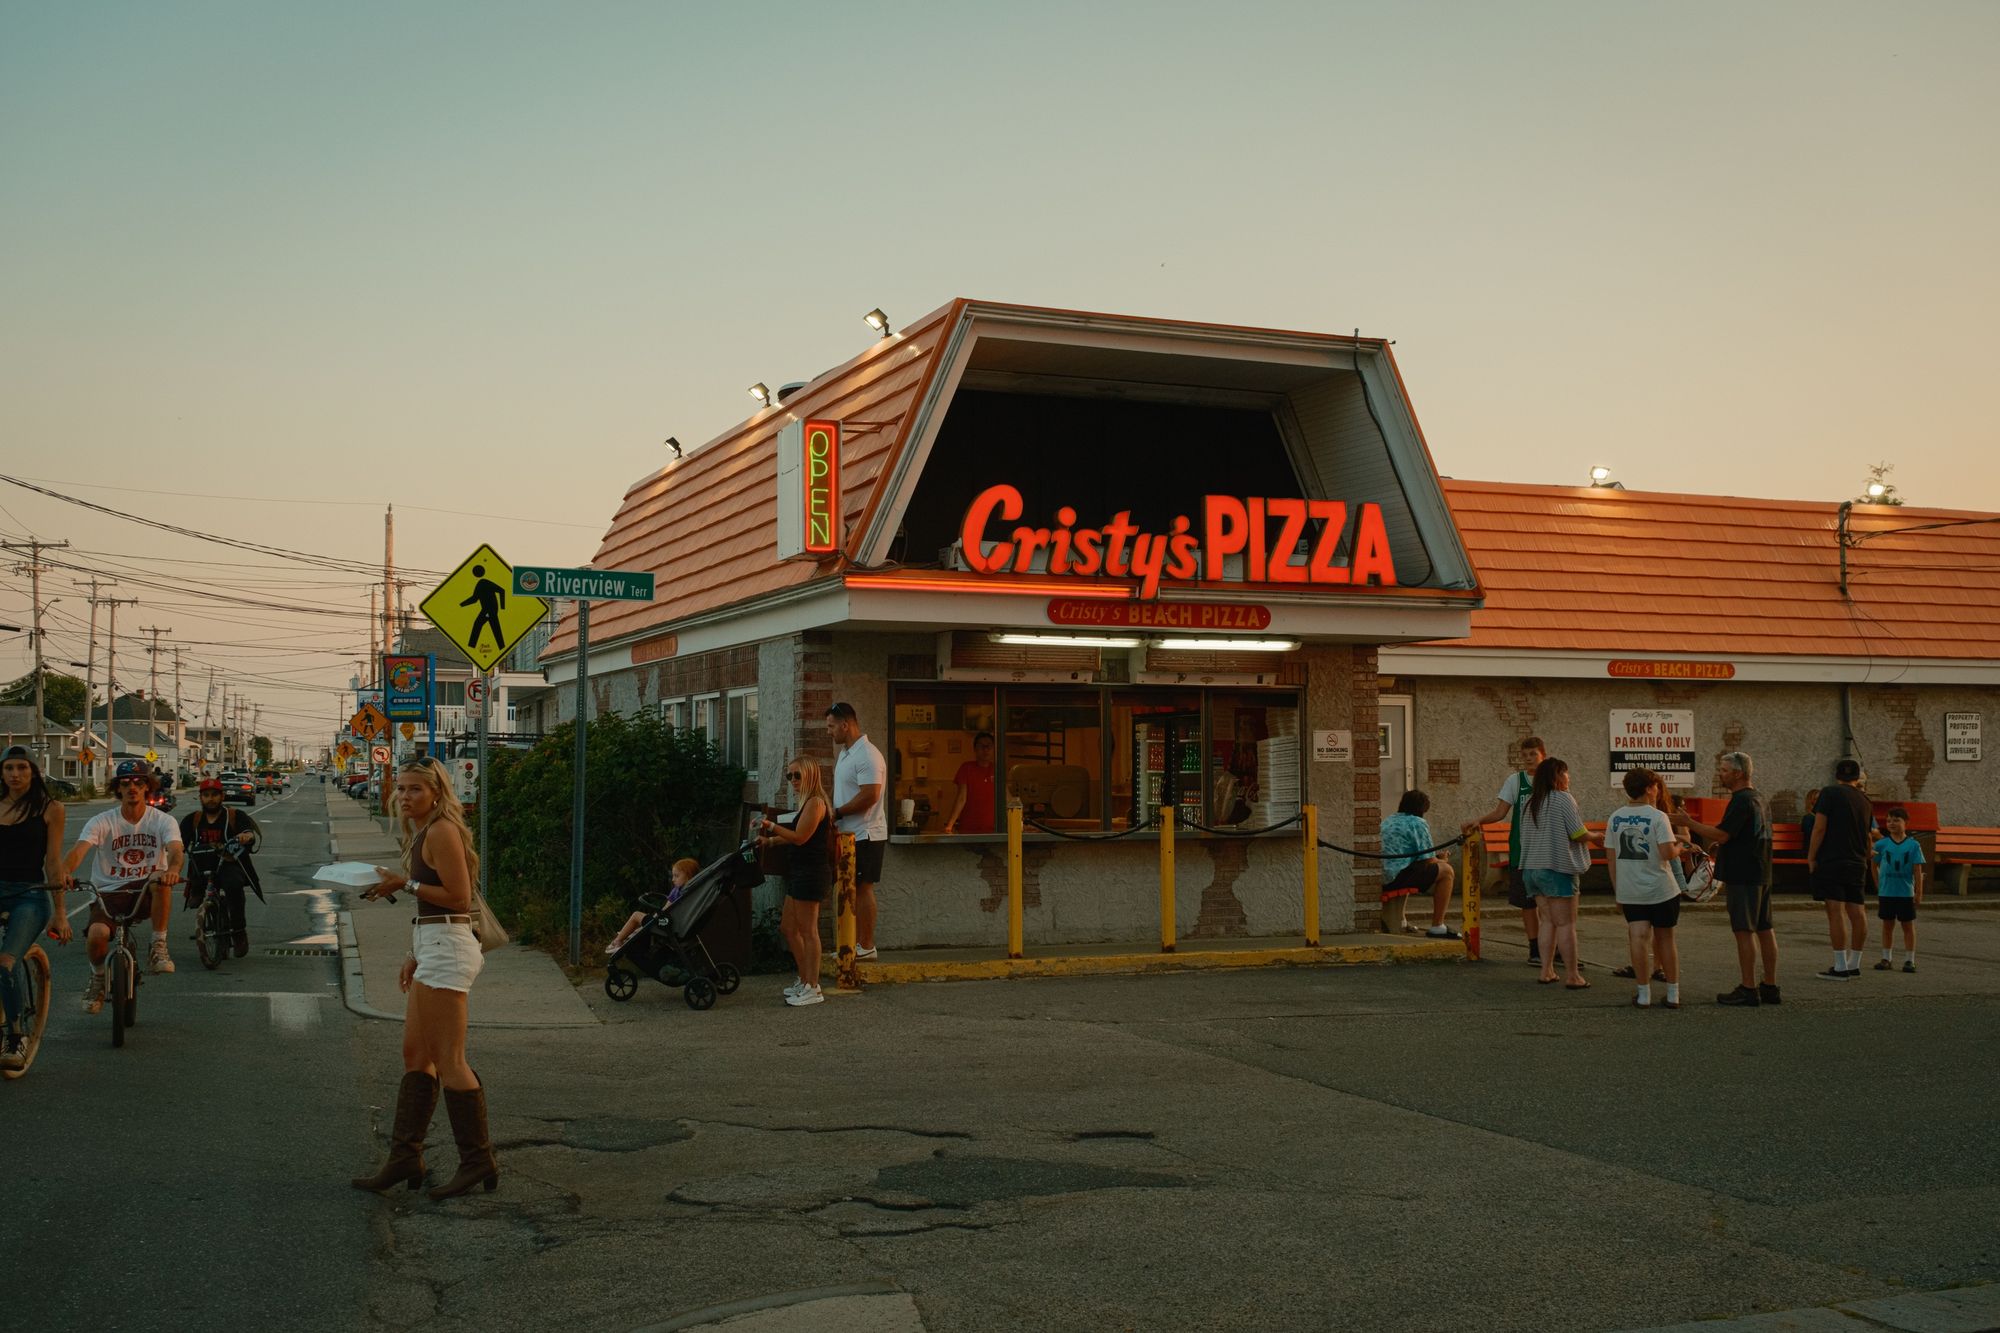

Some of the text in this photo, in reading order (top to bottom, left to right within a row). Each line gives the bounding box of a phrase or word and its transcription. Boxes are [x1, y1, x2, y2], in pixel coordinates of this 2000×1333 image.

[810, 431, 830, 545] OPEN
[960, 484, 1398, 600] Cristy's PIZZA
[545, 571, 648, 597] Riverview Terr
[1059, 601, 1260, 627] Cristy's BEACH PIZZA
[1614, 662, 1729, 677] Cristy's BEACH PIZZA
[1625, 722, 1679, 734] TAKE OUT
[1615, 737, 1691, 748] PARKING ONLY
[1667, 762, 1691, 770] GARAGE
[112, 834, 131, 850] ONE
